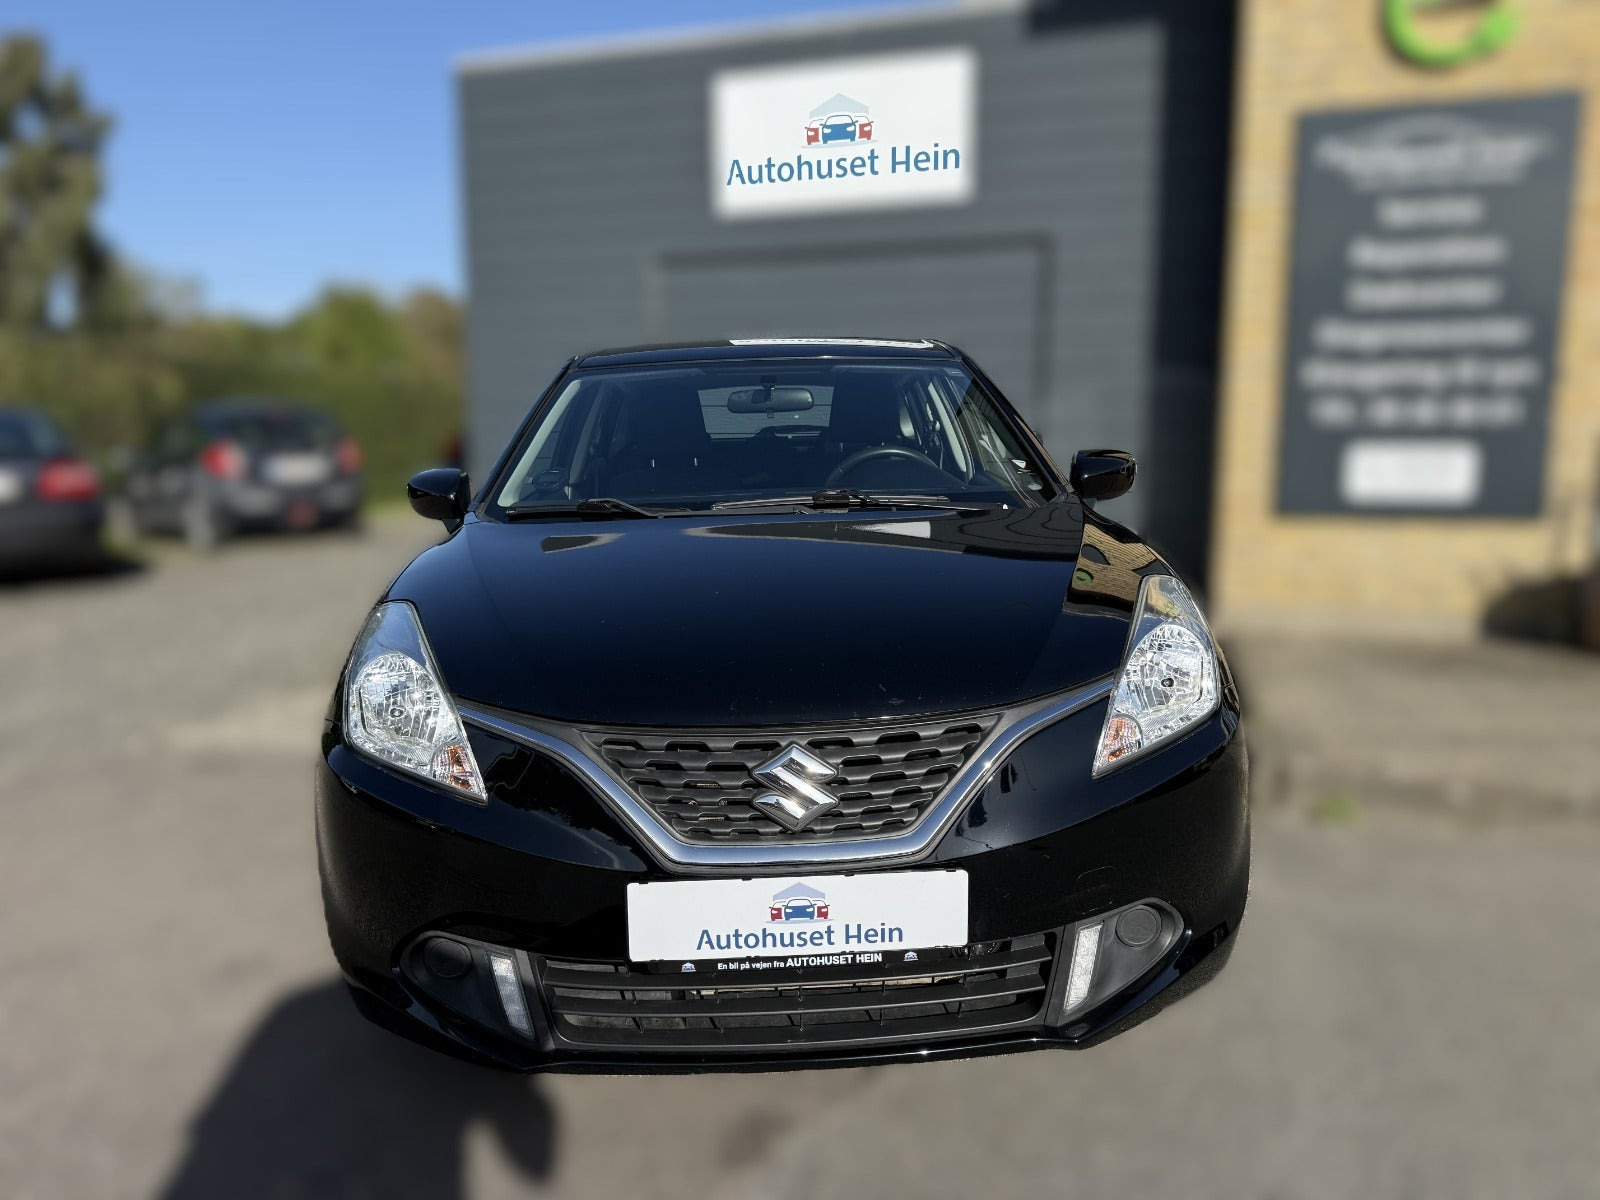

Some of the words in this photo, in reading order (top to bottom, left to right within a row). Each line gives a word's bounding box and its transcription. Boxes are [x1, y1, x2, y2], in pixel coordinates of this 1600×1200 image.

[726, 148, 879, 186] Autohuset
[891, 142, 960, 174] Hein
[696, 924, 835, 951] Autohuset
[844, 922, 904, 945] Hein
[717, 962, 728, 970] En
[729, 961, 739, 970] bil
[740, 960, 750, 970] på
[751, 961, 772, 970] vejen
[773, 960, 785, 968] fra
[786, 954, 853, 968] AUTOHUSET
[855, 953, 882, 963] HEIN
